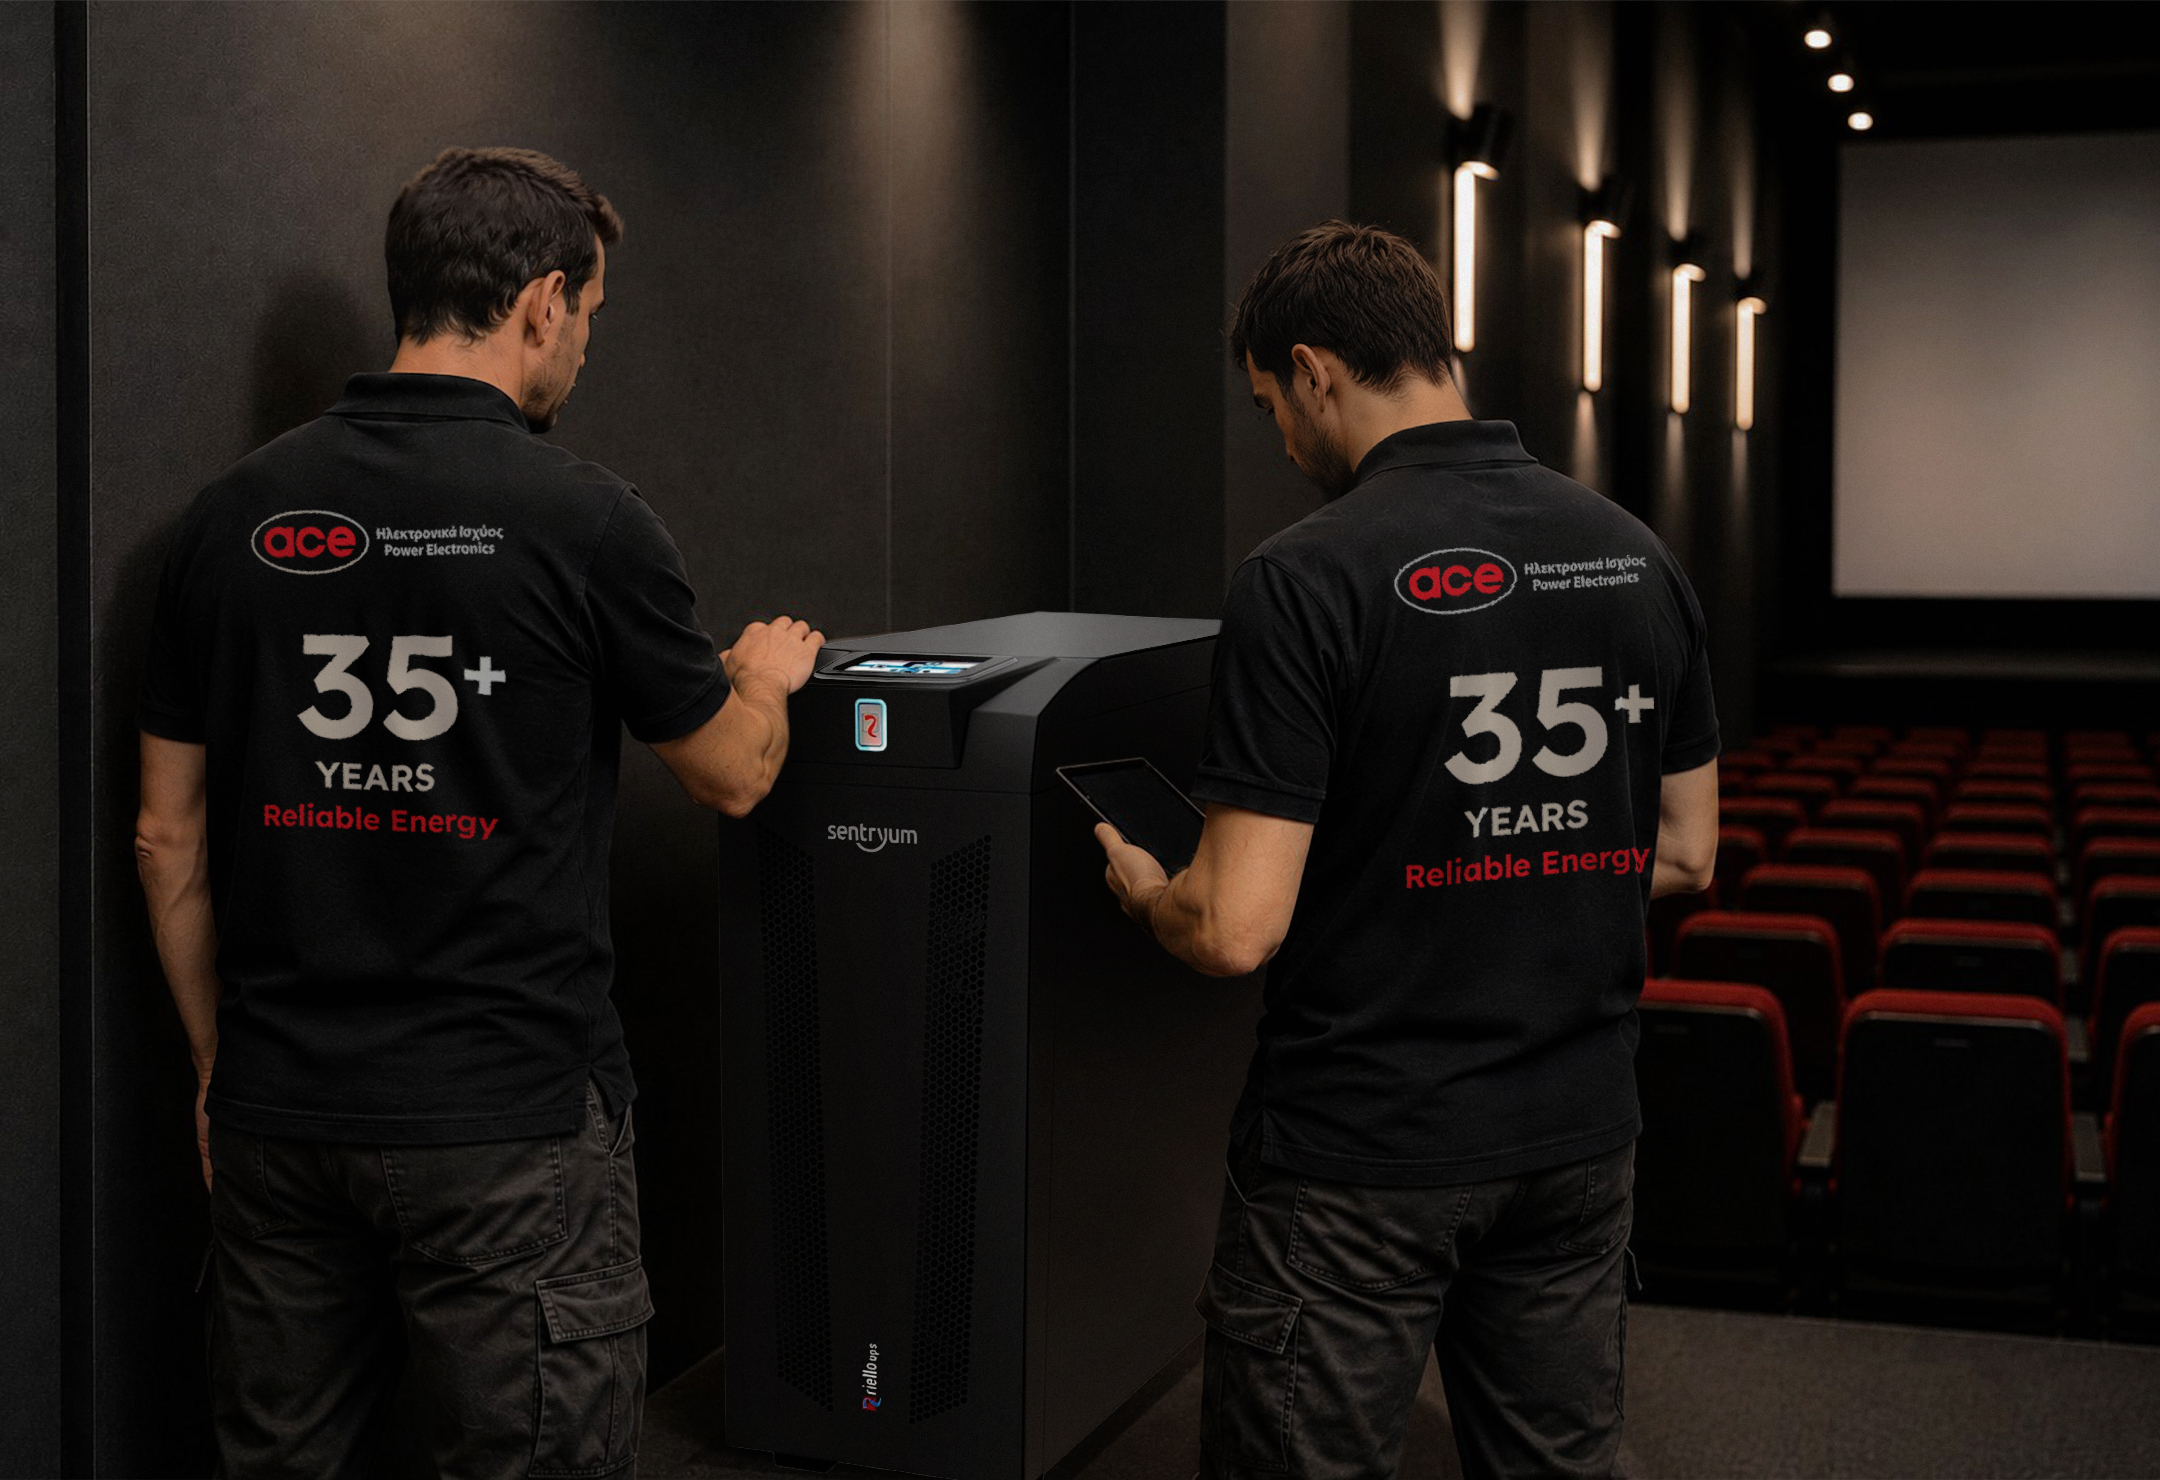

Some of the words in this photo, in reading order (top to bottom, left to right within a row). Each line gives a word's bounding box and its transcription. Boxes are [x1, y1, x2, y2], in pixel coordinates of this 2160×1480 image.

[263, 525, 357, 559] ace
[375, 525, 458, 543] Ηλεκτρονικά
[384, 543, 424, 557] Power
[425, 541, 496, 556] Electronics
[1408, 562, 1504, 601] ace
[1523, 557, 1604, 576] Ηλεκτρονικά
[1532, 578, 1571, 592] Power
[1573, 571, 1640, 589] Electronics
[297, 633, 507, 741] 35+
[1444, 666, 1655, 785] 35+
[314, 760, 436, 793] YEARS
[263, 802, 381, 831] Reliable
[391, 809, 499, 841] Energy
[1464, 799, 1589, 838] YEARS
[827, 823, 918, 853] sentryum
[1405, 853, 1531, 889] Reliable
[1542, 847, 1651, 874] Energy
[869, 1343, 880, 1362] ups
[862, 1362, 878, 1396] riello
